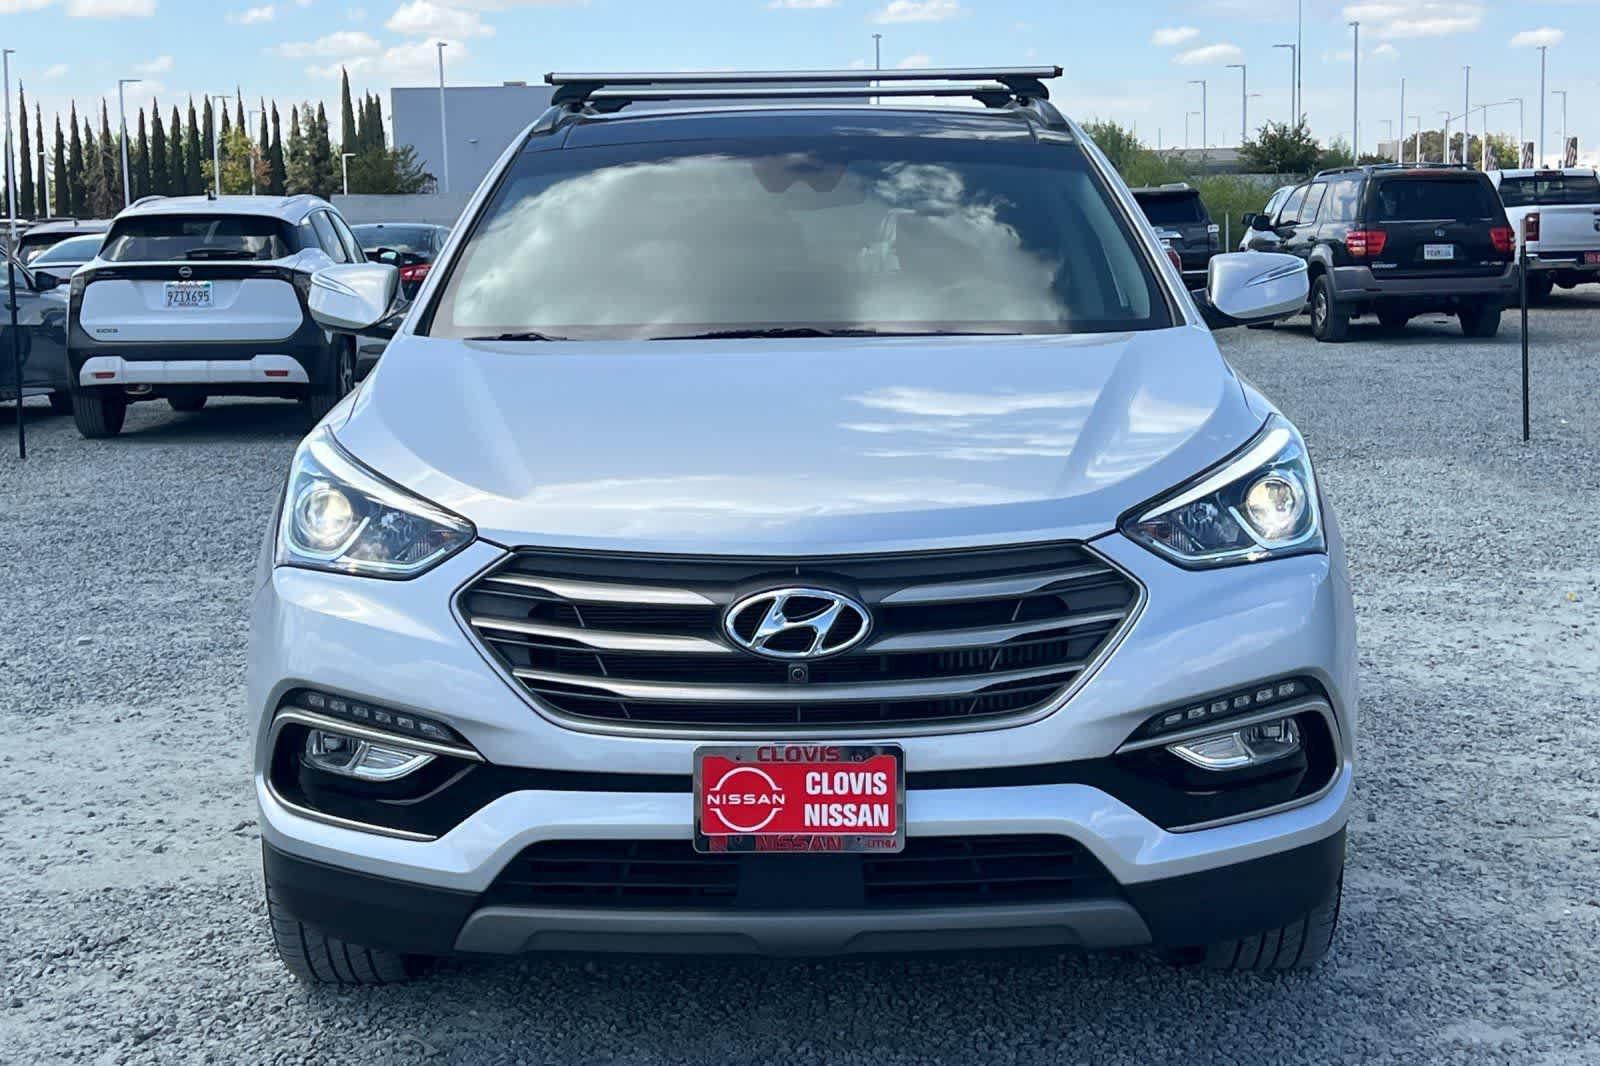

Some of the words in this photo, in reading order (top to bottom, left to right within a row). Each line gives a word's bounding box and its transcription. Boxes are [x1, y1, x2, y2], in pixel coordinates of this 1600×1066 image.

[757, 746, 841, 762] CLOVIS
[806, 772, 887, 795] CLOVIS
[707, 794, 785, 805] NISSAN
[804, 803, 889, 827] NISSAN
[755, 835, 842, 850] NISSAN
